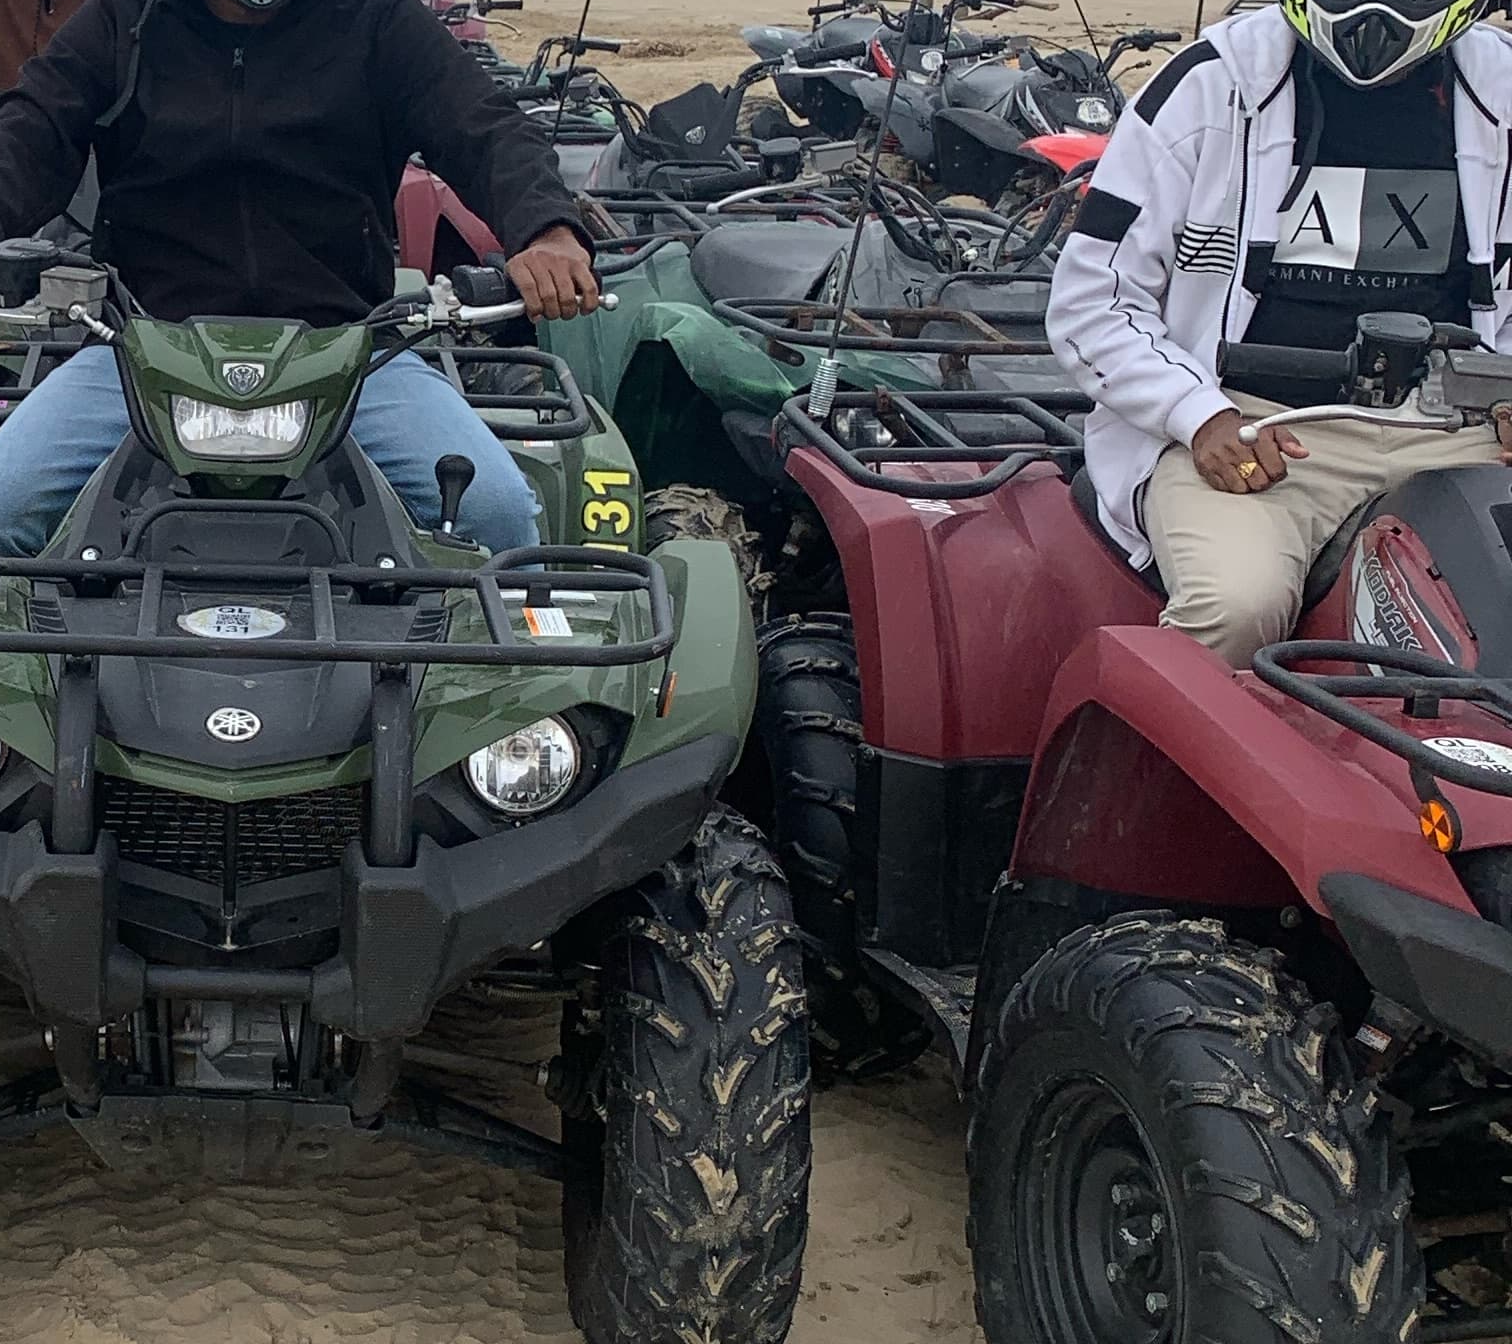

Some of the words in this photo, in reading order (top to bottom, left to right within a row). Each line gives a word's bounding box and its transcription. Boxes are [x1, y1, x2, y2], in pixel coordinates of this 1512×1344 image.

[1289, 189, 1335, 246] A
[1382, 192, 1431, 251] X
[1342, 273, 1419, 289] EXCH
[582, 471, 631, 553] 31
[1365, 547, 1426, 653] KODIAK
[1434, 739, 1478, 748] QL
